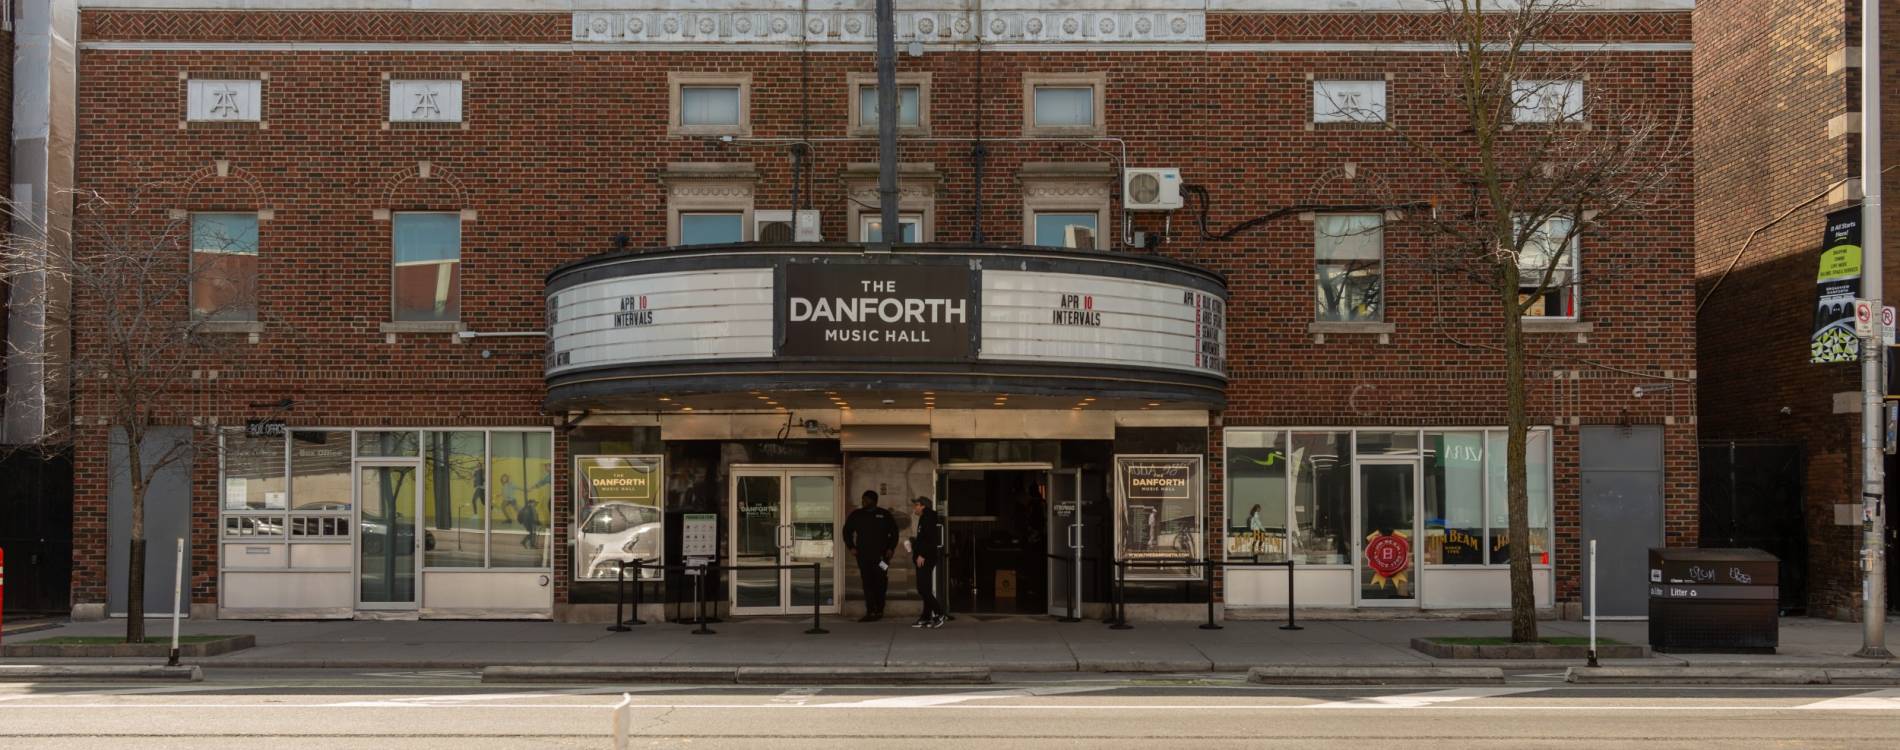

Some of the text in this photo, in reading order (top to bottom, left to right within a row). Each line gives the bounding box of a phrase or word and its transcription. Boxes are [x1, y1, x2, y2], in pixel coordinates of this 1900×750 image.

[1842, 222, 1856, 230] Starts
[861, 280, 896, 292] THE
[621, 295, 648, 310] APR 10
[1060, 294, 1092, 310] APR 10
[1184, 291, 1194, 305] APR
[790, 297, 966, 323] DANFORTH
[614, 311, 652, 328] INTERVALS
[1052, 310, 1100, 326] INTERVALS
[825, 330, 930, 342] MUSIC HALL
[300, 449, 315, 457] Box
[593, 478, 646, 486] DANFORTH
[1132, 478, 1185, 486] DANFORTH
[1428, 528, 1478, 551] JIM BEAM
[1383, 548, 1393, 560] B
[1374, 556, 1389, 568] SINCE
[1670, 588, 1688, 597] Litter
